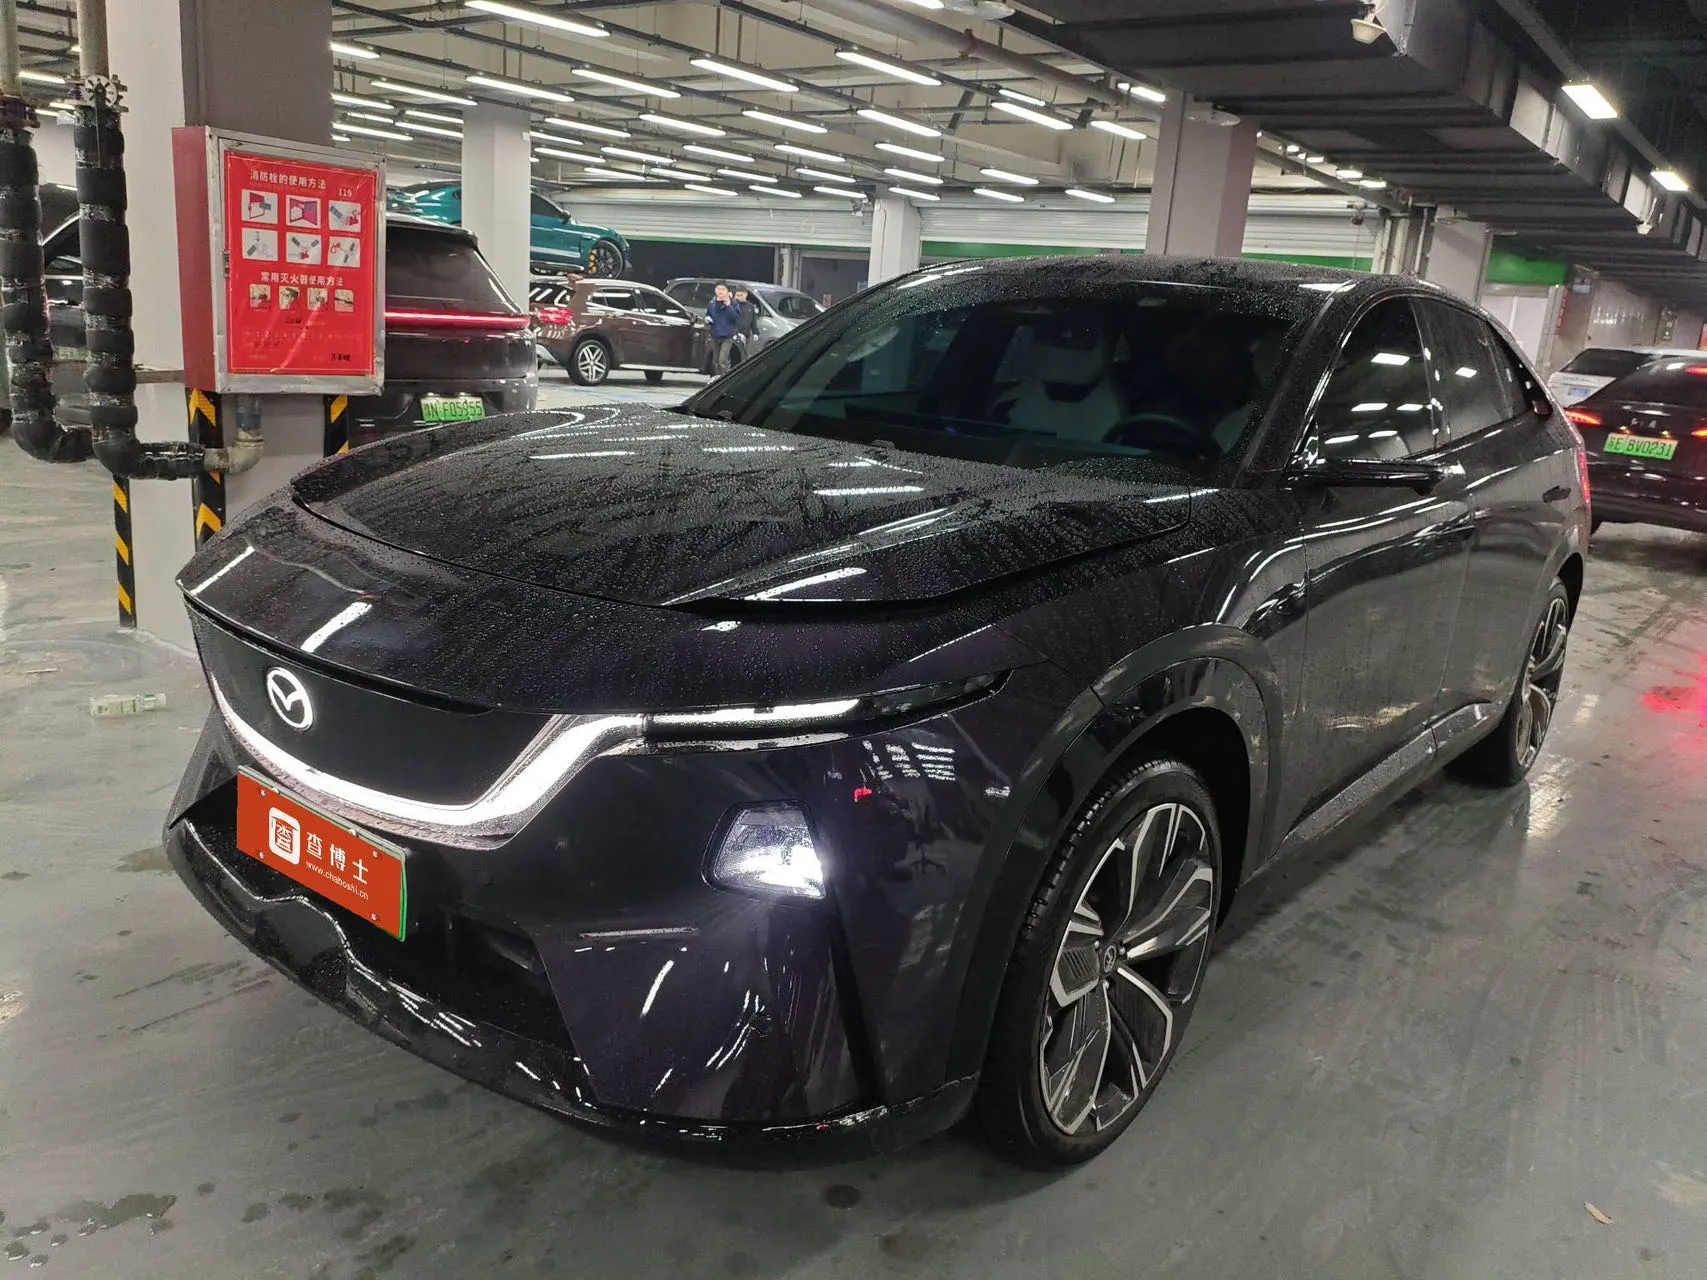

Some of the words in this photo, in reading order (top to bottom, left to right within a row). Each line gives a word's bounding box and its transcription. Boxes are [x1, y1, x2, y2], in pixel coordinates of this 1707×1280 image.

[250, 169, 327, 190] 消防栓的使用方法
[261, 271, 344, 287] 常用灭火器使用方法
